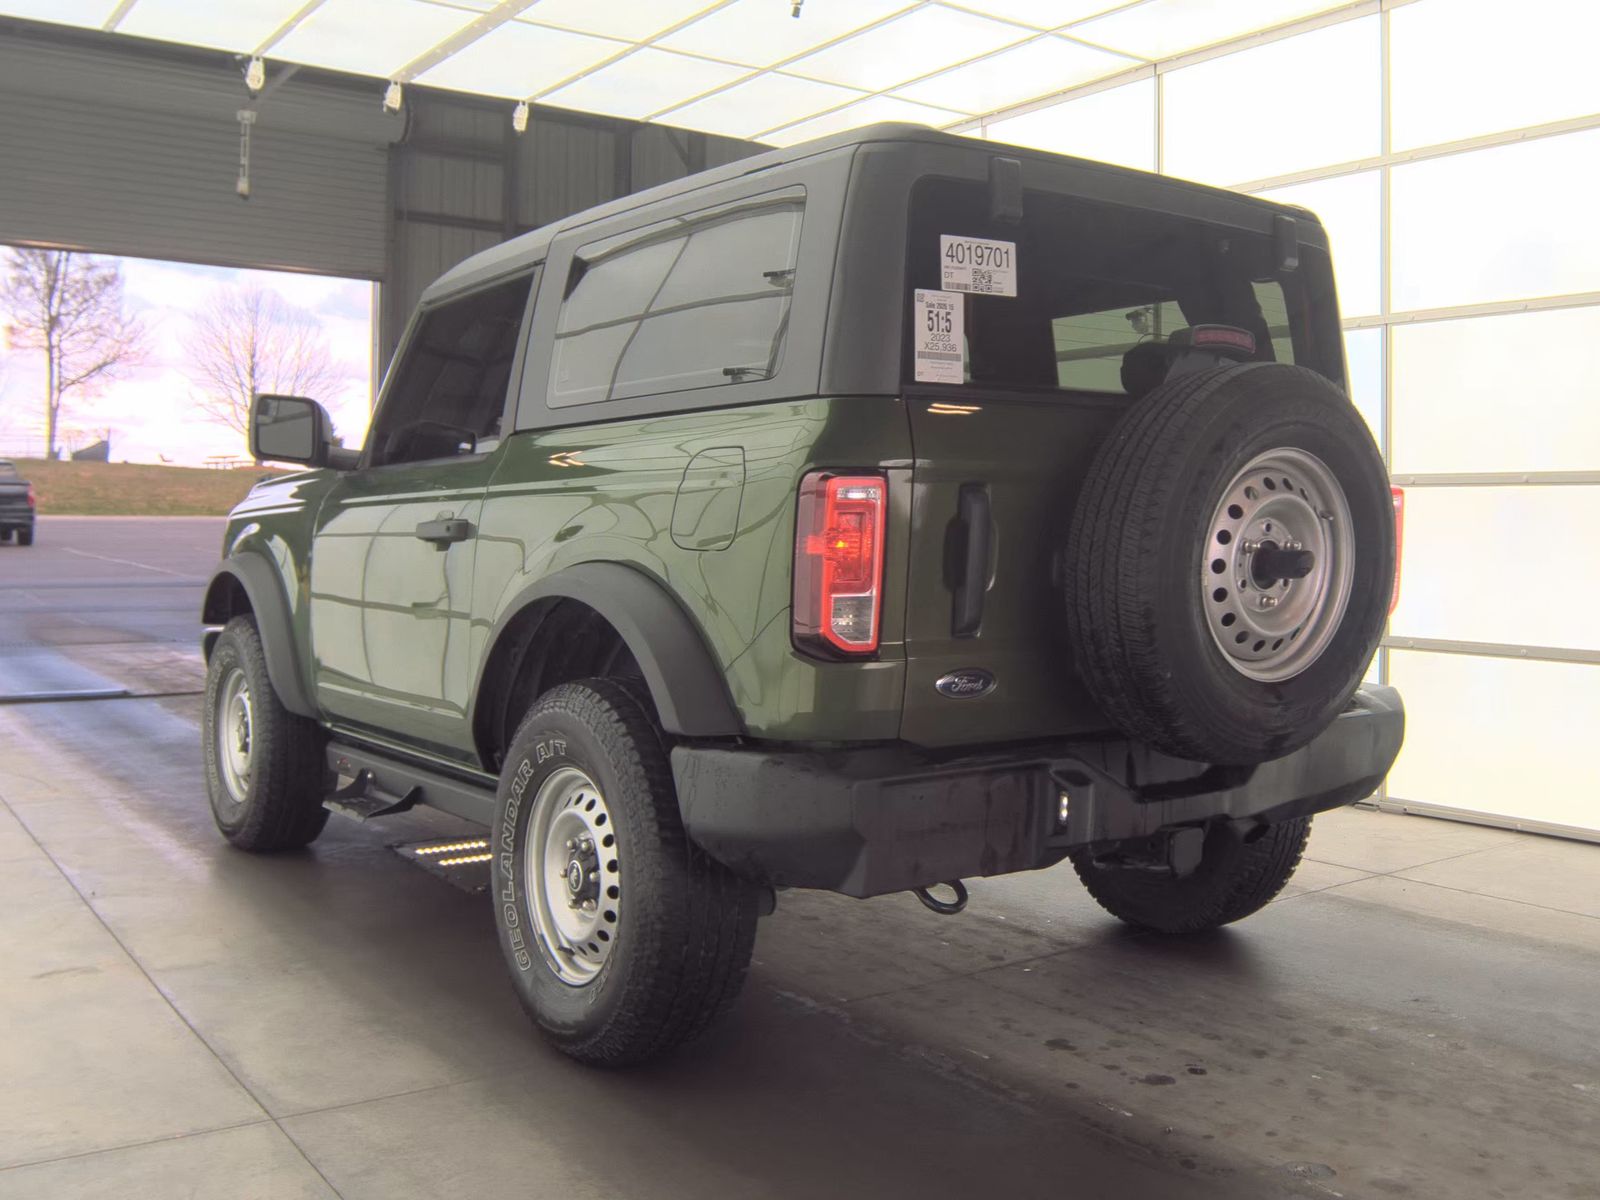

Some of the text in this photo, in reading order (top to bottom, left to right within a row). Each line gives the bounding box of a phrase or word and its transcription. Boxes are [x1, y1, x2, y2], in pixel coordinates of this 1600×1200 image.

[945, 242, 1010, 268] 4019701
[927, 309, 952, 333] 51:5
[930, 333, 951, 343] 2023
[951, 676, 984, 692] Ford
[501, 739, 567, 971] GEOLANDAR A/T
